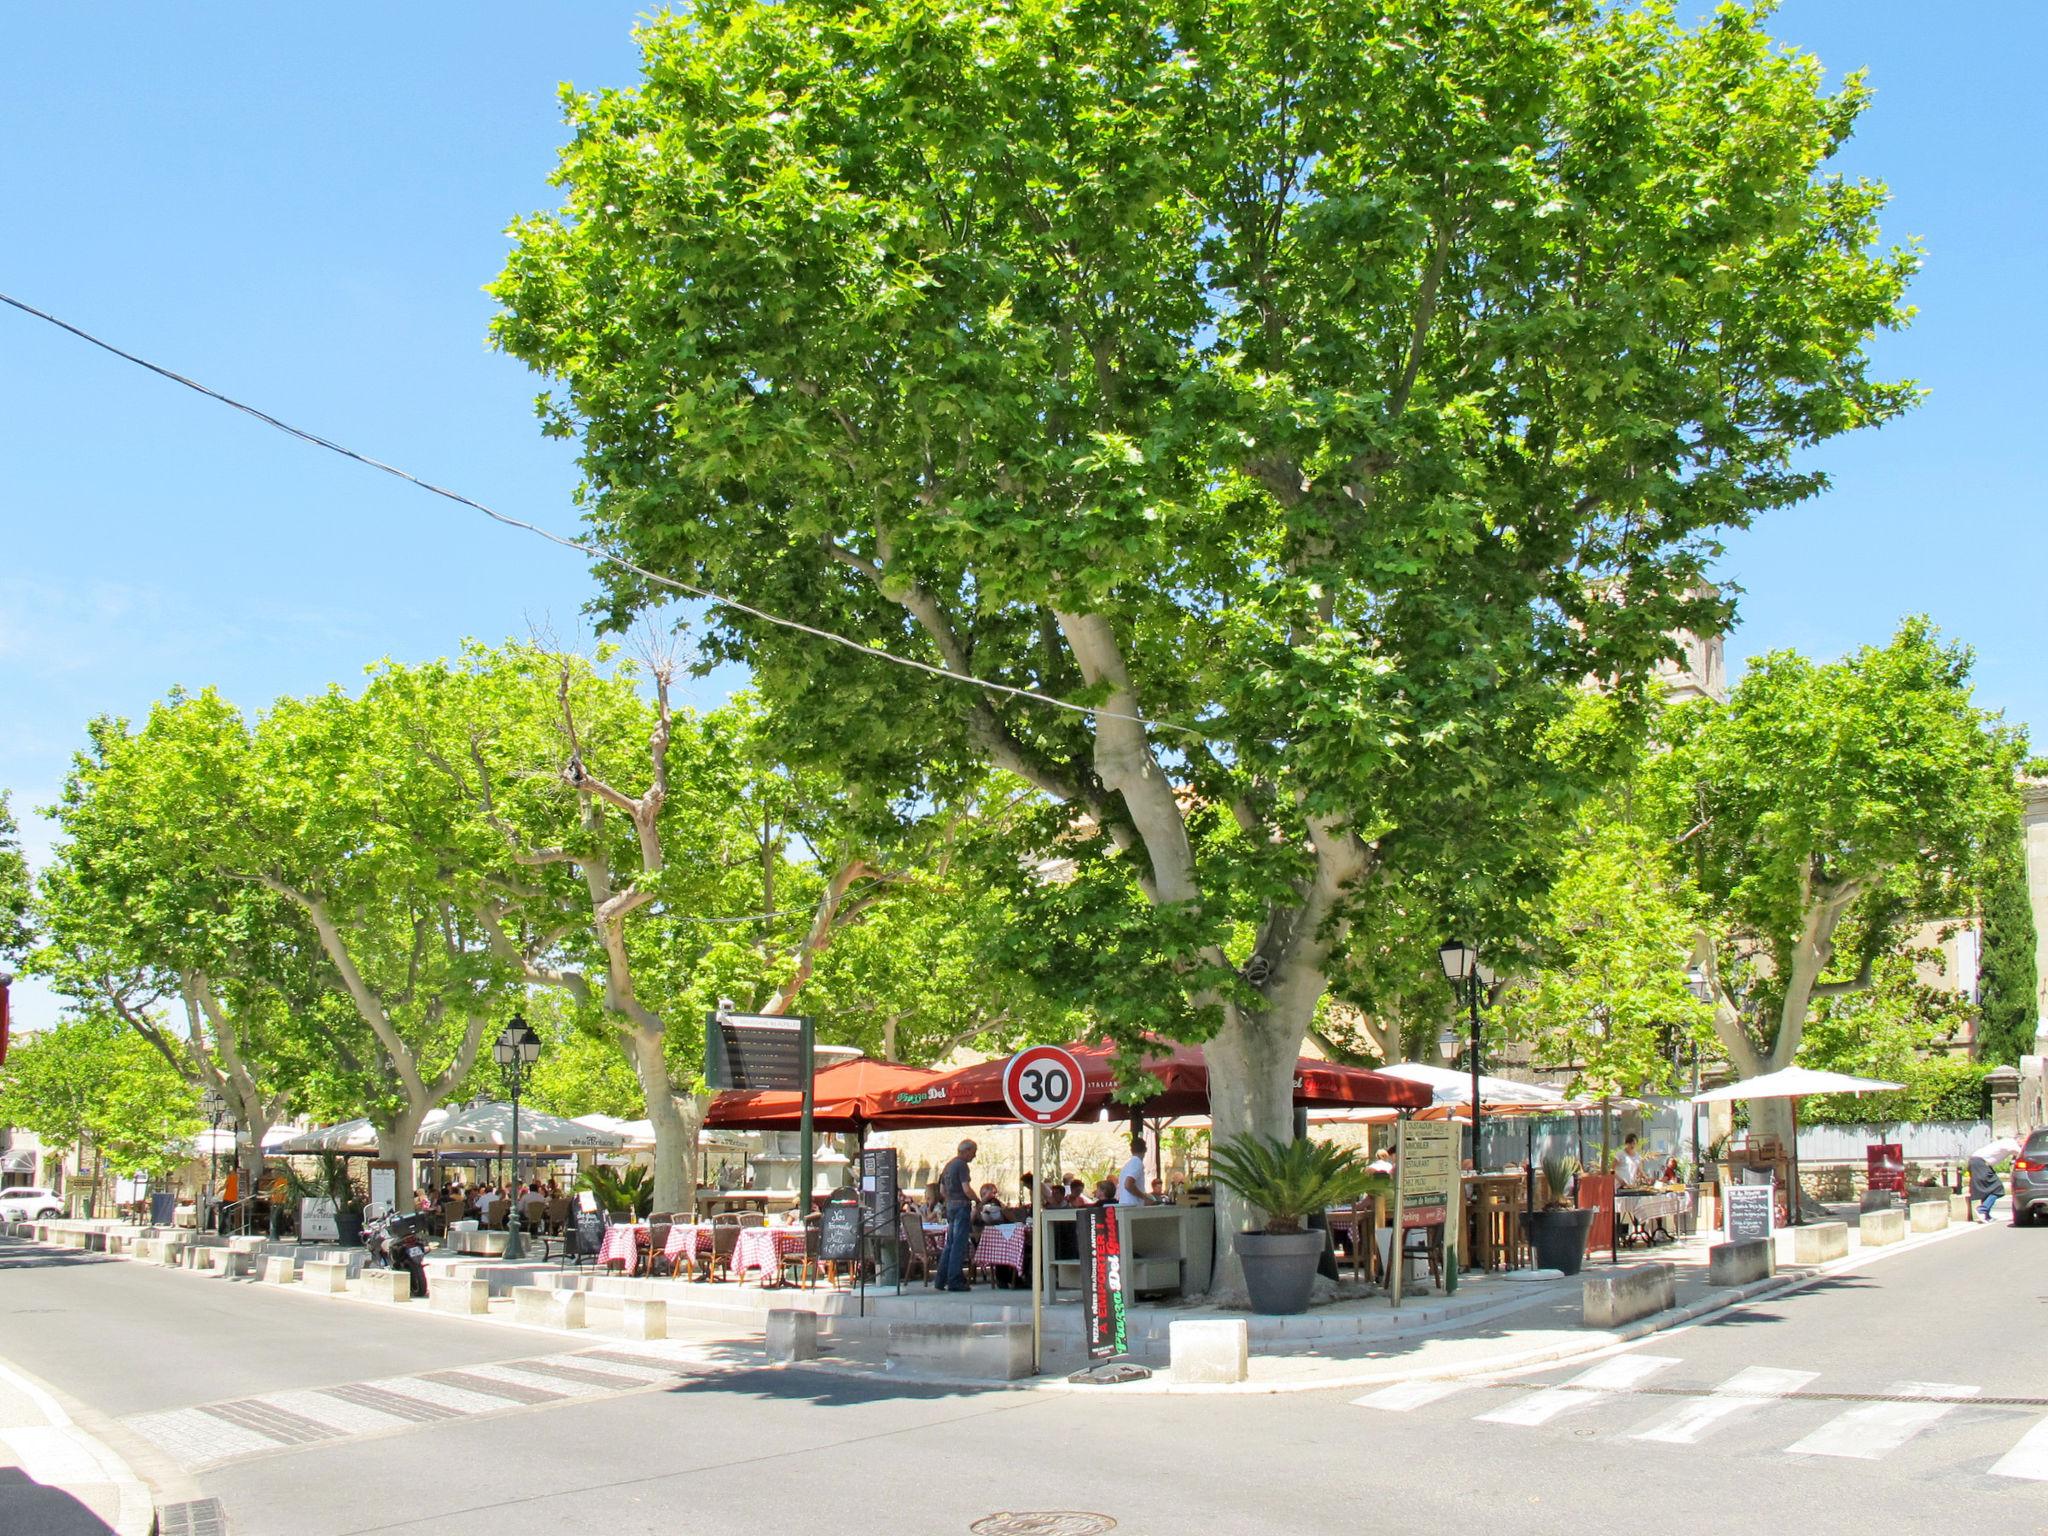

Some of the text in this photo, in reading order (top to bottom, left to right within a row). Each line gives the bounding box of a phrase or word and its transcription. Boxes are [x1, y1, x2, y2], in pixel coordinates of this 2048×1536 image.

[896, 1092, 928, 1105] Piazza
[927, 1086, 947, 1100] Del
[1022, 1069, 1069, 1103] 30
[1291, 1076, 1303, 1089] el
[1096, 1235, 1108, 1318] EMPORTER
[1105, 1206, 1127, 1354] Piazza Del Gusto
